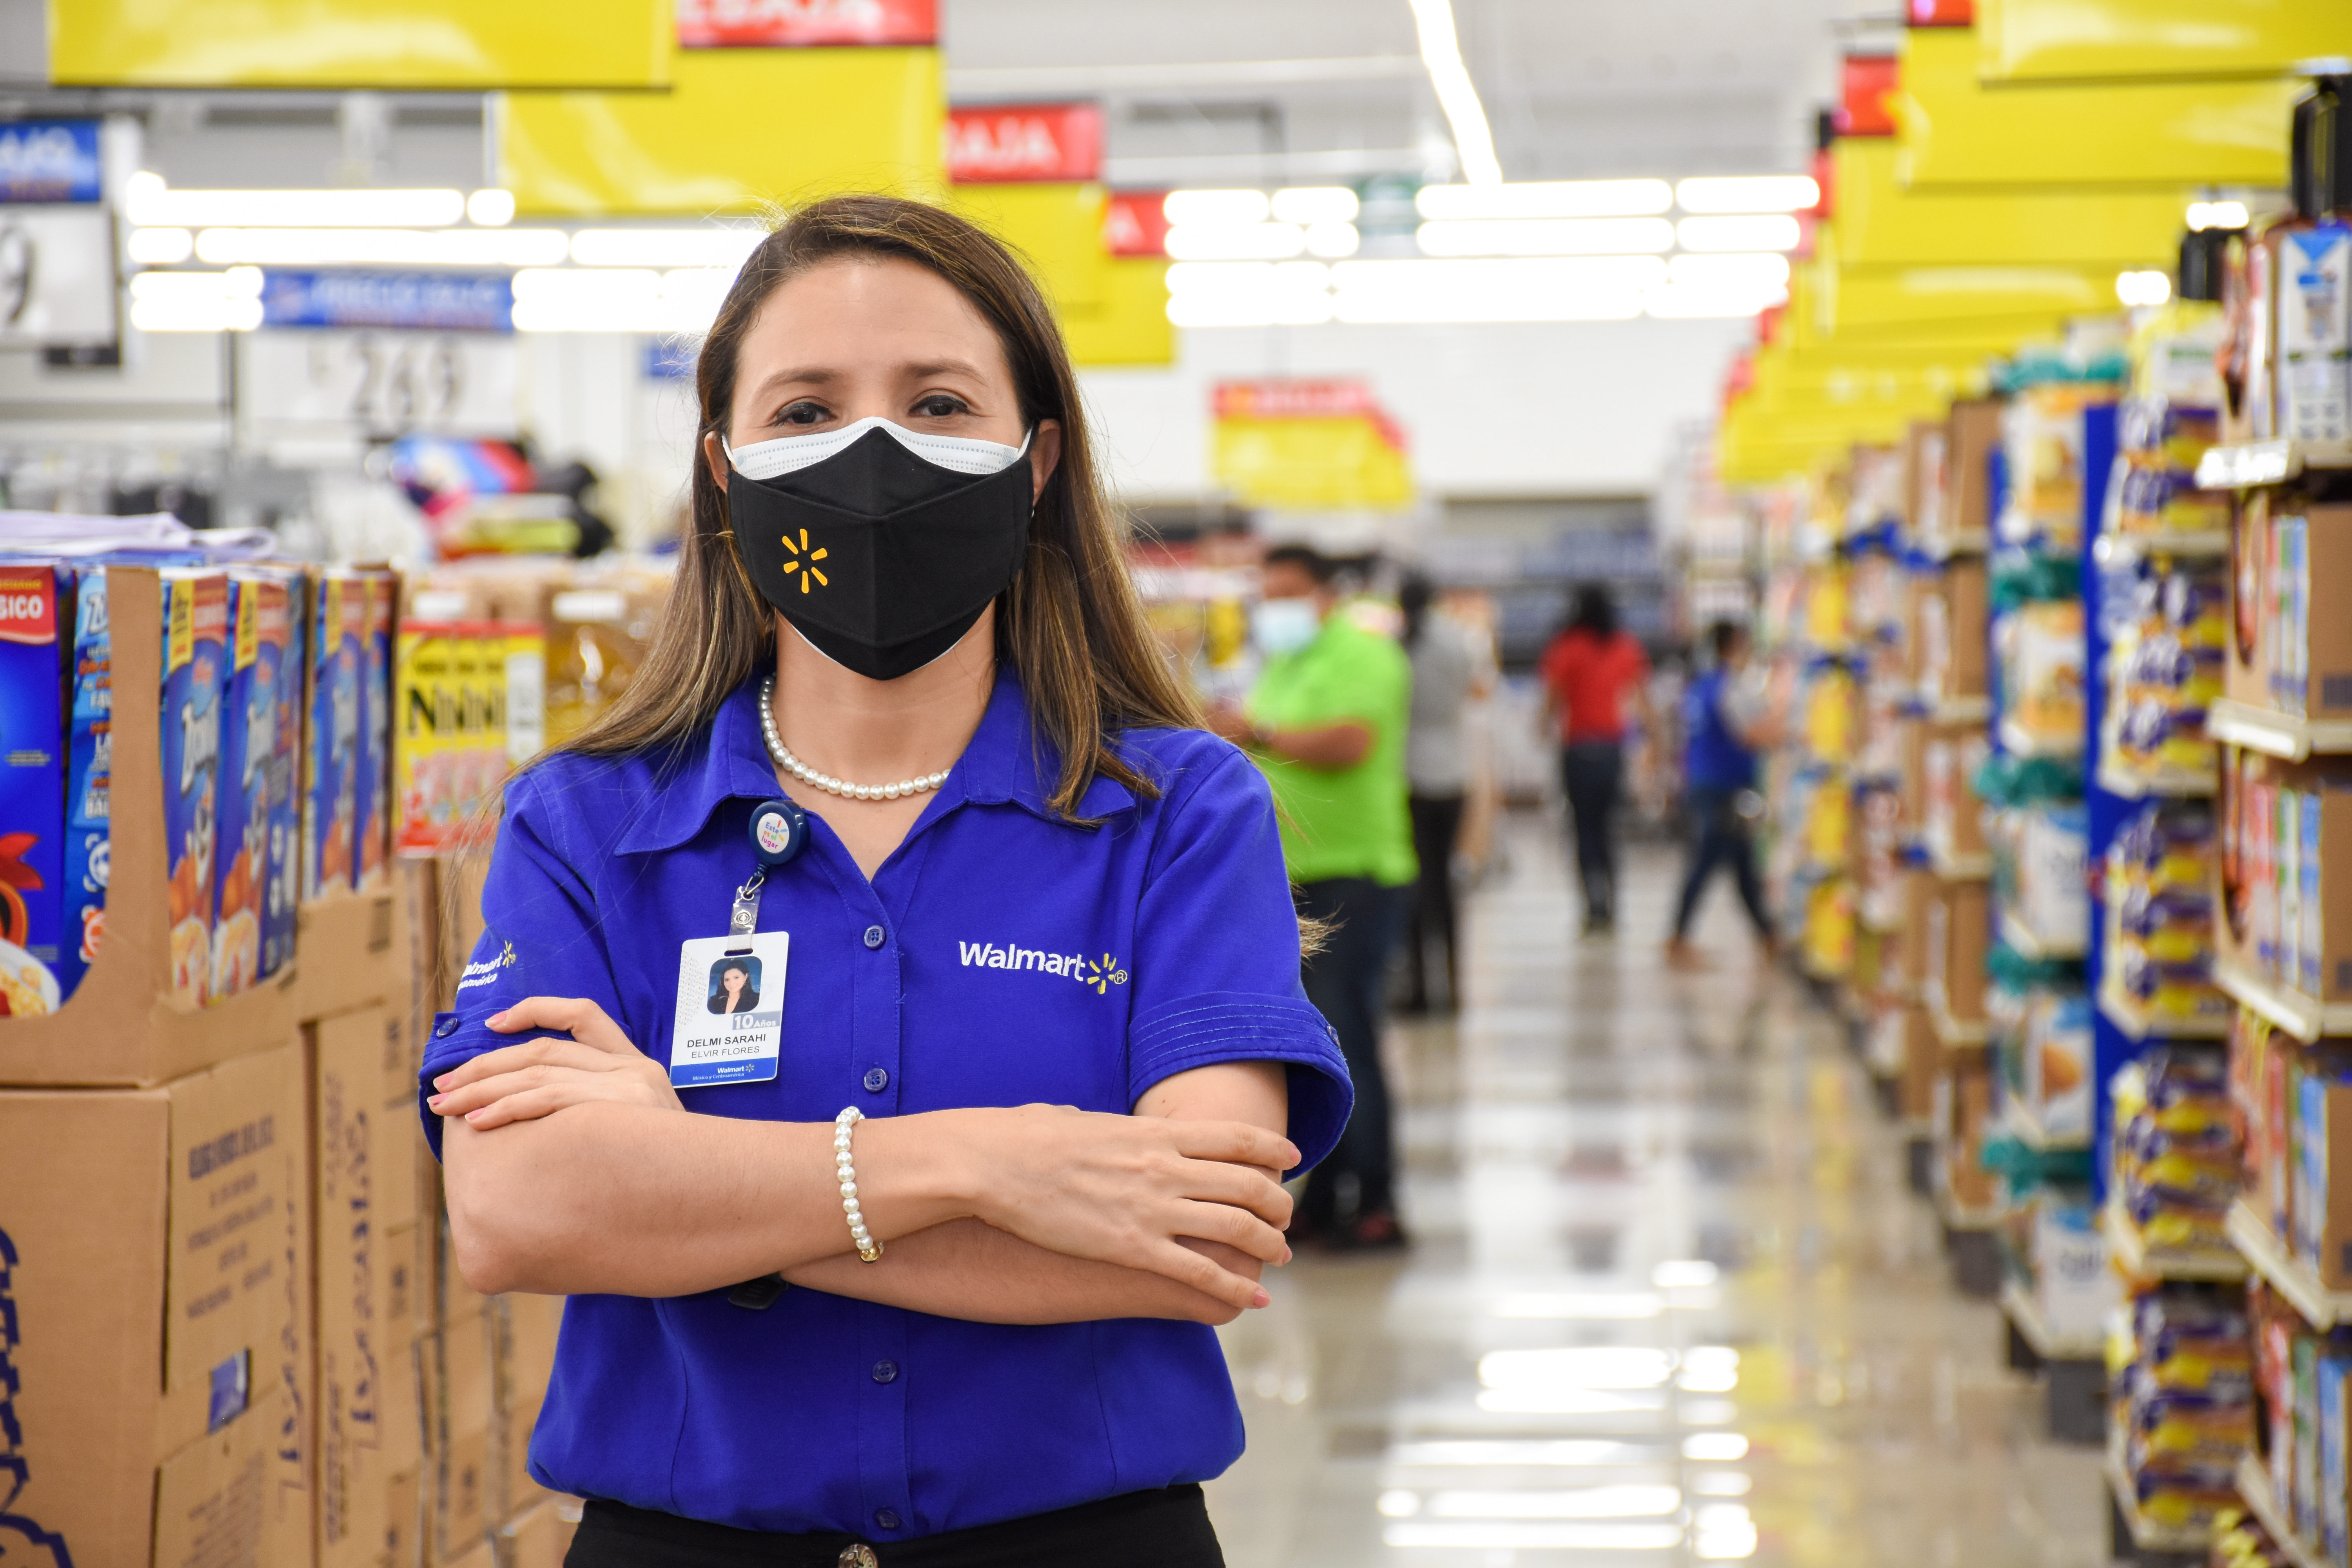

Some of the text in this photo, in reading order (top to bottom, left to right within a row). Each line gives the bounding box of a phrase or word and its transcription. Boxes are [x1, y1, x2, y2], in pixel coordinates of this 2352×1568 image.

[766, 822, 779, 834] Este
[762, 835, 778, 849] lugar
[958, 941, 1086, 982] Walmart
[734, 1014, 776, 1030] 10 Años
[687, 1034, 766, 1048] DELMI SARAHI
[691, 1046, 760, 1058] ELVIR FLORES
